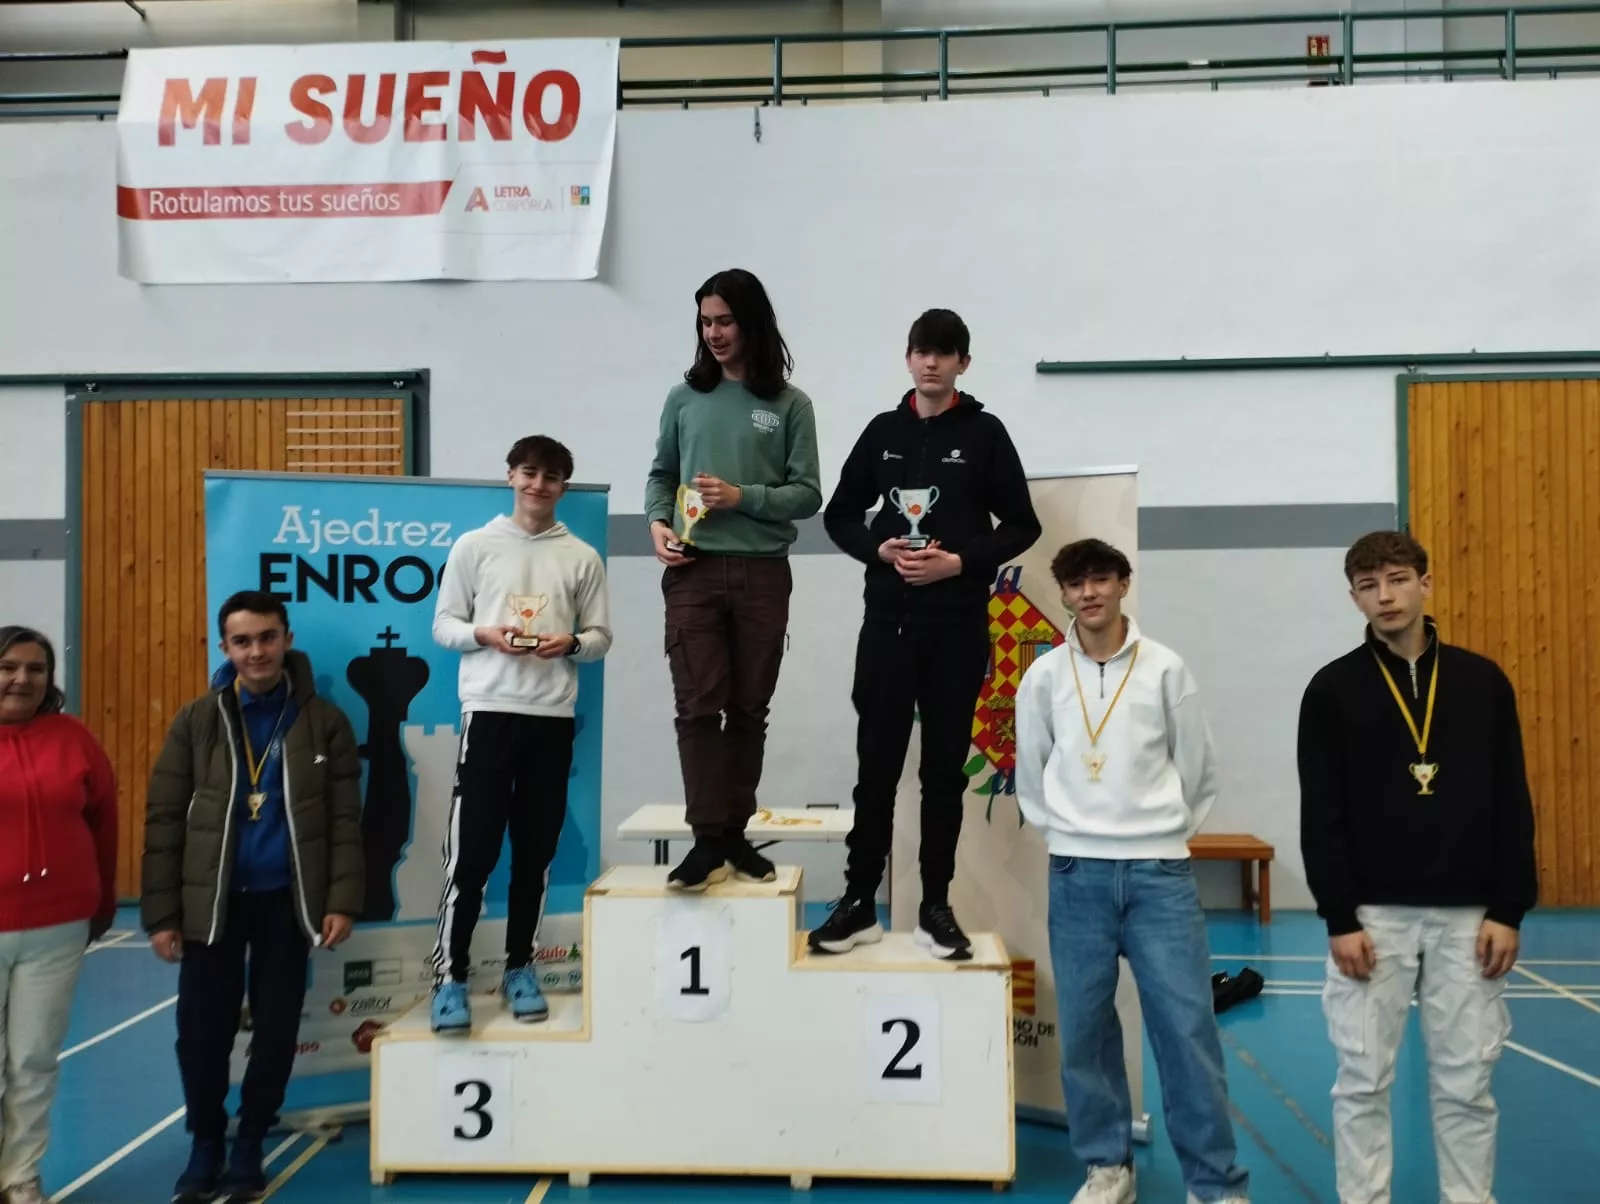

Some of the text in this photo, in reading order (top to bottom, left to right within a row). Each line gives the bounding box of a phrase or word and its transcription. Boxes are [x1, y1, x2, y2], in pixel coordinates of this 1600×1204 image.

[158, 50, 581, 147] MI SUEÑO
[149, 187, 401, 215] Rotulamos tus sueños
[494, 185, 531, 198] LETRA
[272, 505, 453, 554] Ajedrez
[259, 552, 449, 604] ENRO
[680, 946, 710, 996] 1
[881, 1018, 922, 1080] 2
[453, 1079, 494, 1141] 3
